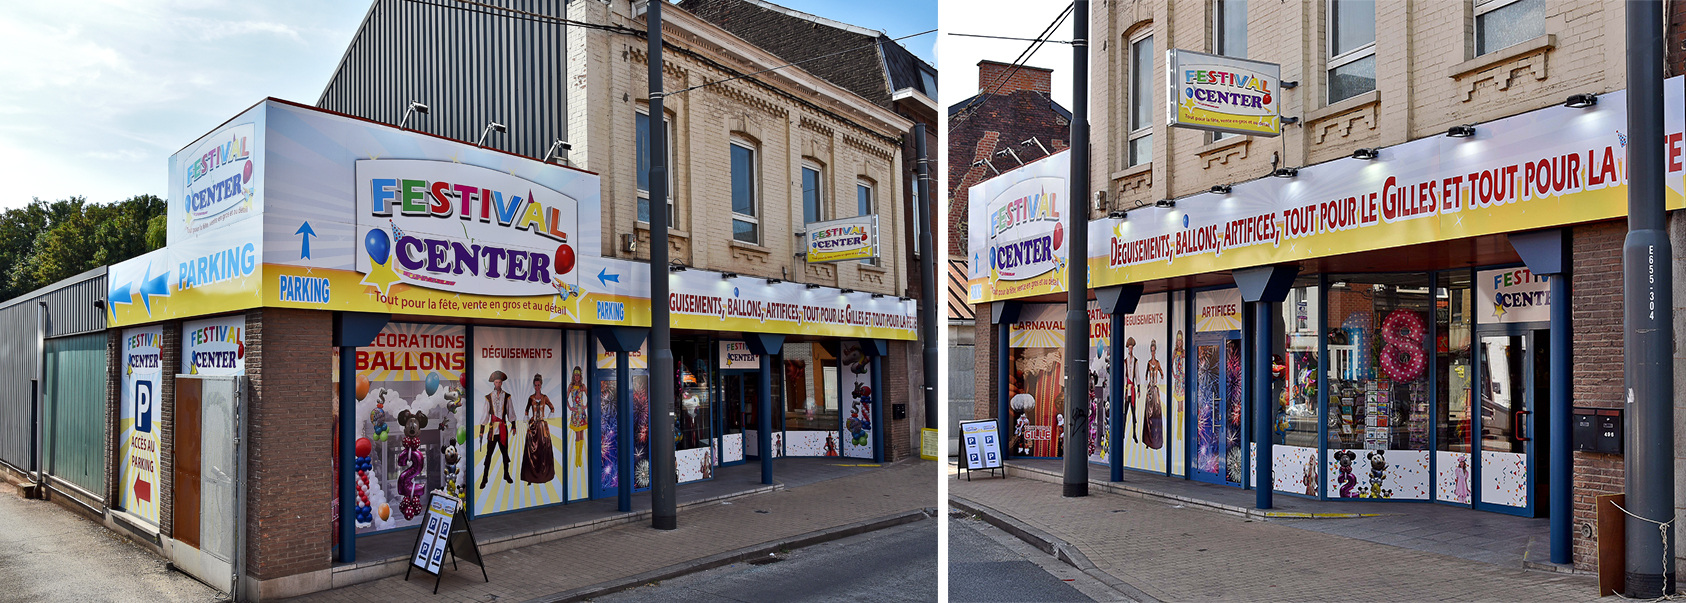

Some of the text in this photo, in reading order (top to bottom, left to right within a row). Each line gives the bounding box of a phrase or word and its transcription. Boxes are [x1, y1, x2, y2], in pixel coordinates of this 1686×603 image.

[1185, 70, 1271, 95] FESTIVAL
[1194, 88, 1262, 108] CENTER
[187, 136, 249, 187] FESTIVAL
[191, 173, 242, 211] CENTER
[371, 178, 567, 243] FESTIVAL
[991, 192, 1060, 239] FESTIVAL
[1110, 234, 1174, 266] DÉGUISEMENTS,
[1176, 224, 1220, 254] BALLONS,
[1224, 212, 1280, 245] ARTIFICES,
[1284, 205, 1316, 236] TOUT
[1320, 196, 1356, 230] POUR
[1362, 192, 1378, 224] LE
[1442, 176, 1463, 210] ET
[1468, 164, 1518, 206] TOUT
[1525, 153, 1580, 197] POUR
[1588, 146, 1617, 186] LA
[812, 226, 866, 240] FESTIVAL
[818, 237, 861, 248] CENTER
[395, 235, 551, 283] CENTER
[997, 236, 1052, 270] CENTER
[178, 242, 255, 290] PARKING
[279, 275, 330, 303] PARKING
[374, 290, 567, 316] Tout pour la fête, vente en gros et au détail
[1502, 291, 1550, 308] CENTE
[597, 300, 624, 321] PARKING
[669, 292, 726, 319] GUISEMENTS,
[728, 298, 764, 322] BALLONS,
[766, 302, 802, 324] ARTIFICES,
[802, 306, 820, 321] TOUT
[820, 307, 837, 323] POUR
[838, 308, 844, 324] LE
[865, 312, 872, 326] ET
[872, 312, 886, 328] TOUT
[886, 314, 899, 328] POUR
[900, 315, 906, 329] LA
[1202, 304, 1236, 318] ARTIFICES
[1012, 320, 1066, 330] CARNAVAL
[128, 333, 162, 350] FESTIVAL
[191, 326, 242, 347] FESTIVAL
[132, 354, 158, 368] CENTER
[196, 351, 236, 368] CENTER
[356, 351, 465, 370] BALLONS
[482, 344, 553, 358] DÉGUISEMENTS
[730, 354, 756, 362] CENTER
[131, 436, 156, 452] ACCÈS AU
[1024, 430, 1050, 440] GILLE
[132, 455, 154, 473] PARKING
